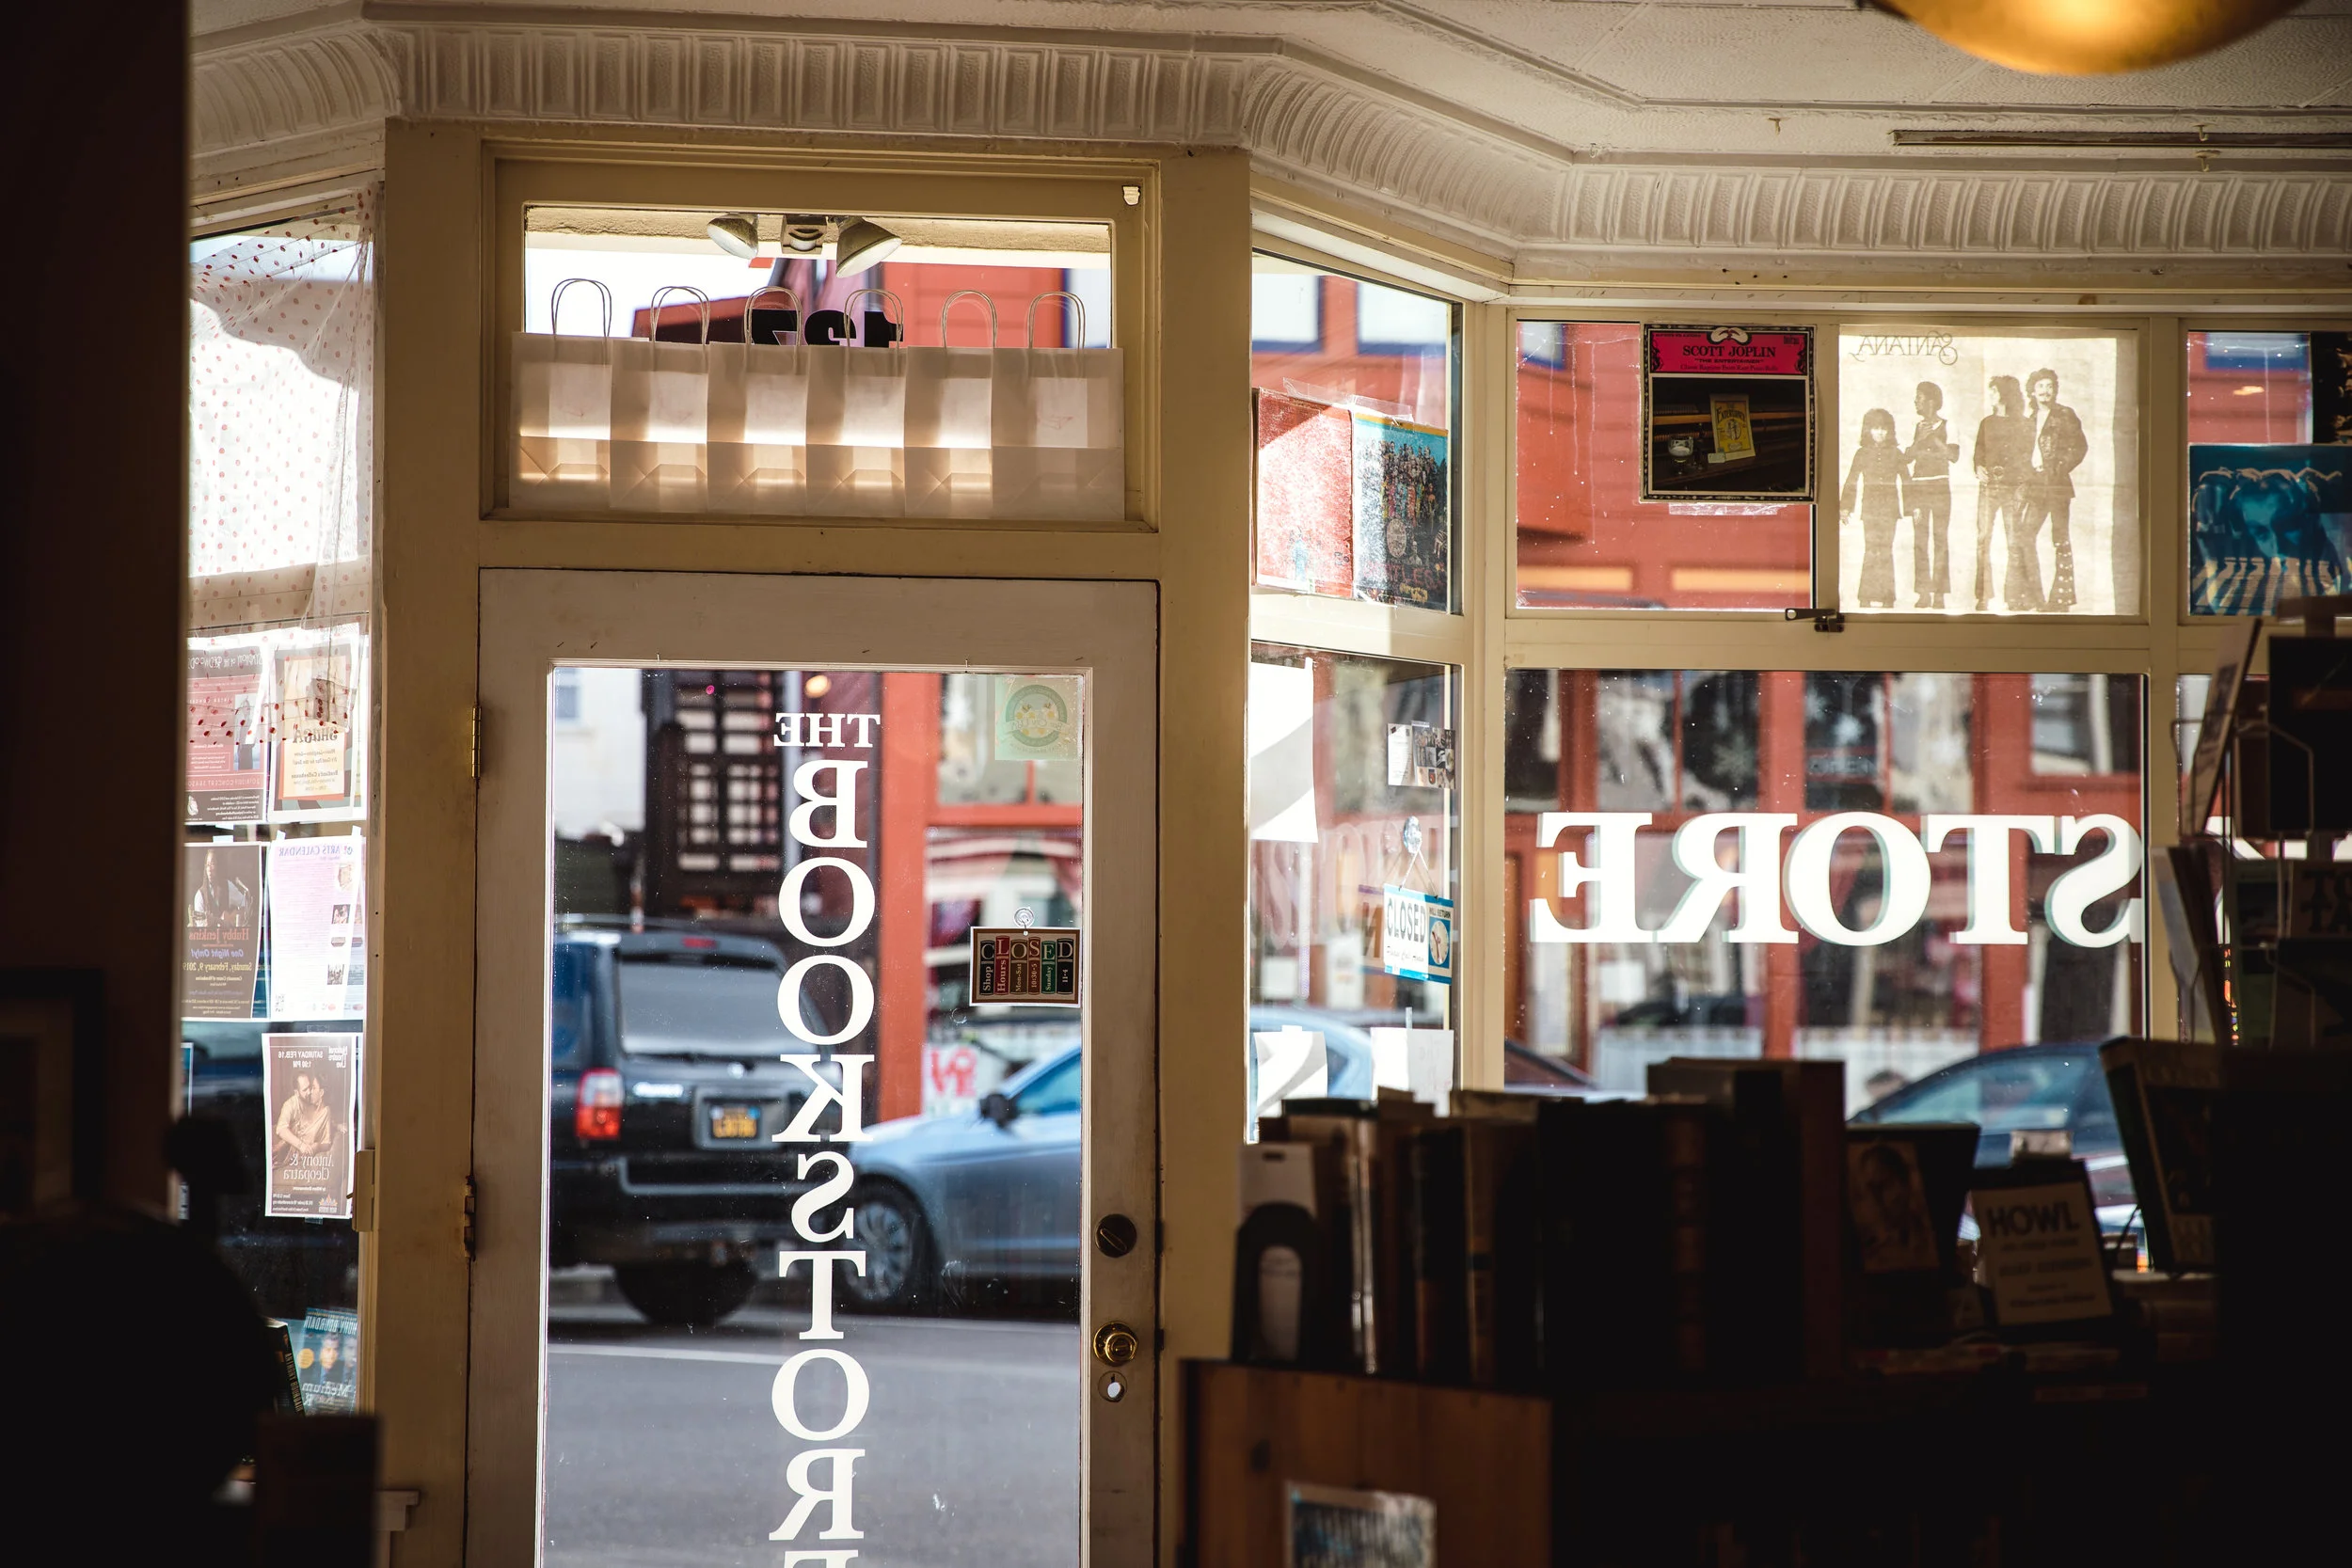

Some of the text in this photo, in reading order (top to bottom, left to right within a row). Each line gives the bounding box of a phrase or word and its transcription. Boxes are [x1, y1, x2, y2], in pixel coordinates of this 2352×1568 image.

[1682, 345, 1776, 357] SCOTT JOPLIN
[1387, 897, 1426, 943] CLOSED
[1438, 909, 1452, 920] RETURN
[980, 939, 1073, 960] CLOSED
[982, 966, 993, 991] Shop
[996, 959, 1007, 992] Hours
[1045, 966, 1054, 990] Sunday
[1985, 1201, 2081, 1239] HOWL
